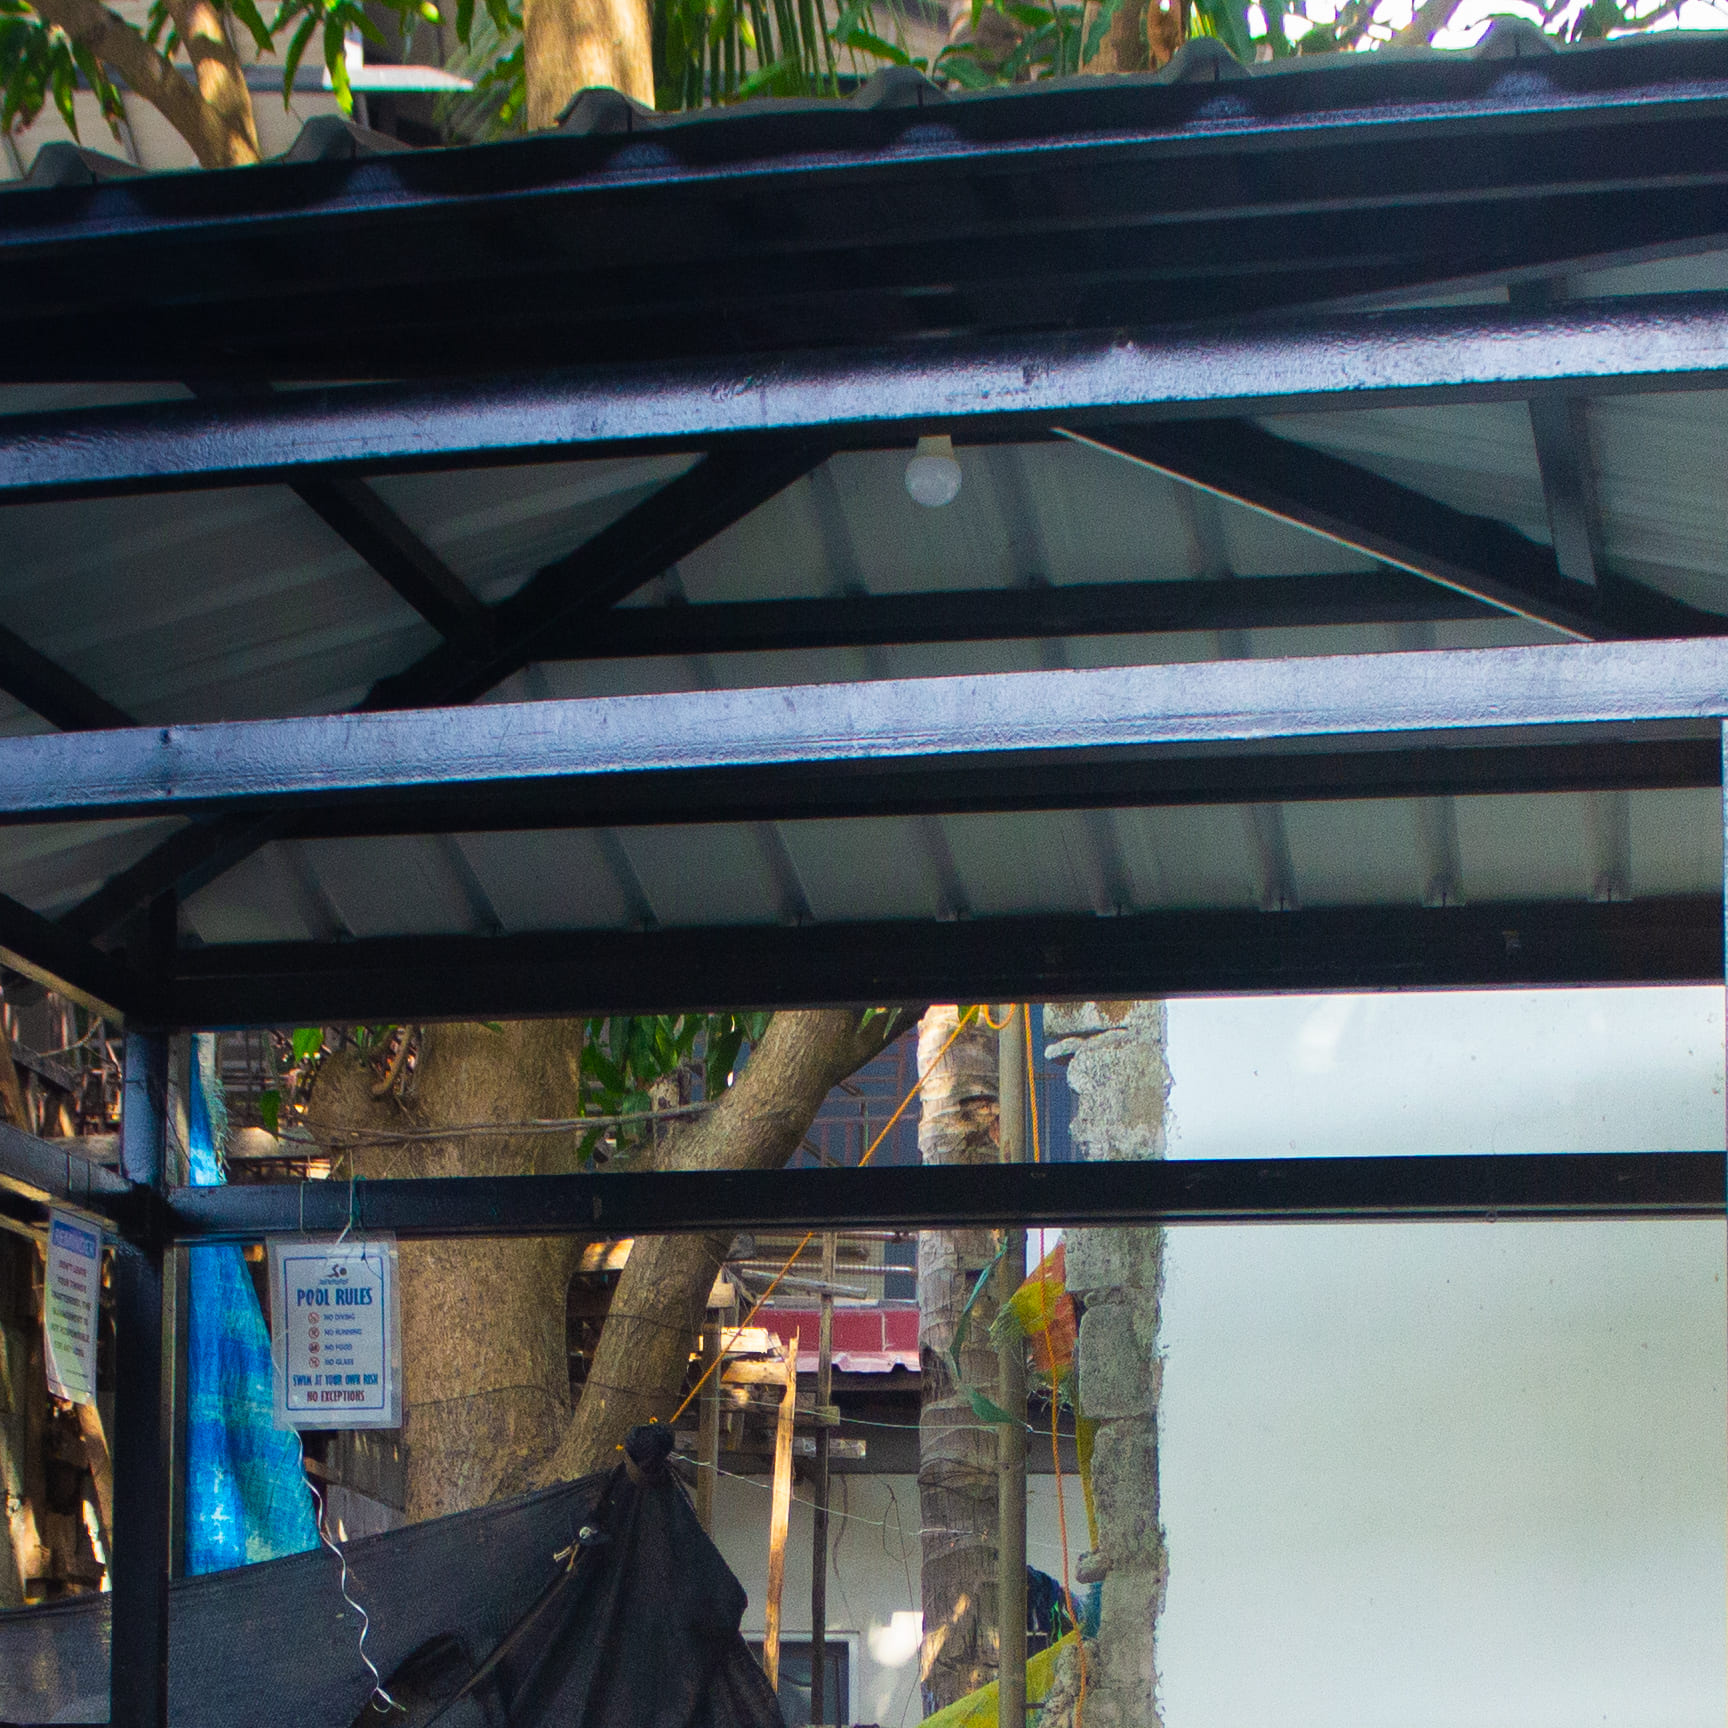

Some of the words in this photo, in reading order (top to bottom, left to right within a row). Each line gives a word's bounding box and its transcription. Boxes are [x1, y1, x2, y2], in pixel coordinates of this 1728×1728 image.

[297, 1288, 330, 1306] POOL
[335, 1287, 373, 1306] RULES
[324, 1313, 334, 1321] NO
[335, 1313, 355, 1321] DIVING
[335, 1343, 353, 1351] FOOD
[325, 1358, 334, 1366] NO
[335, 1358, 354, 1366] GLASS
[293, 1374, 312, 1386] SWIM
[314, 1374, 322, 1386] AT
[325, 1374, 342, 1386] YOUR
[345, 1374, 361, 1385] OWN
[363, 1373, 379, 1385] RISK
[306, 1390, 318, 1402] NO
[320, 1390, 365, 1402] EXCEPTIONS
